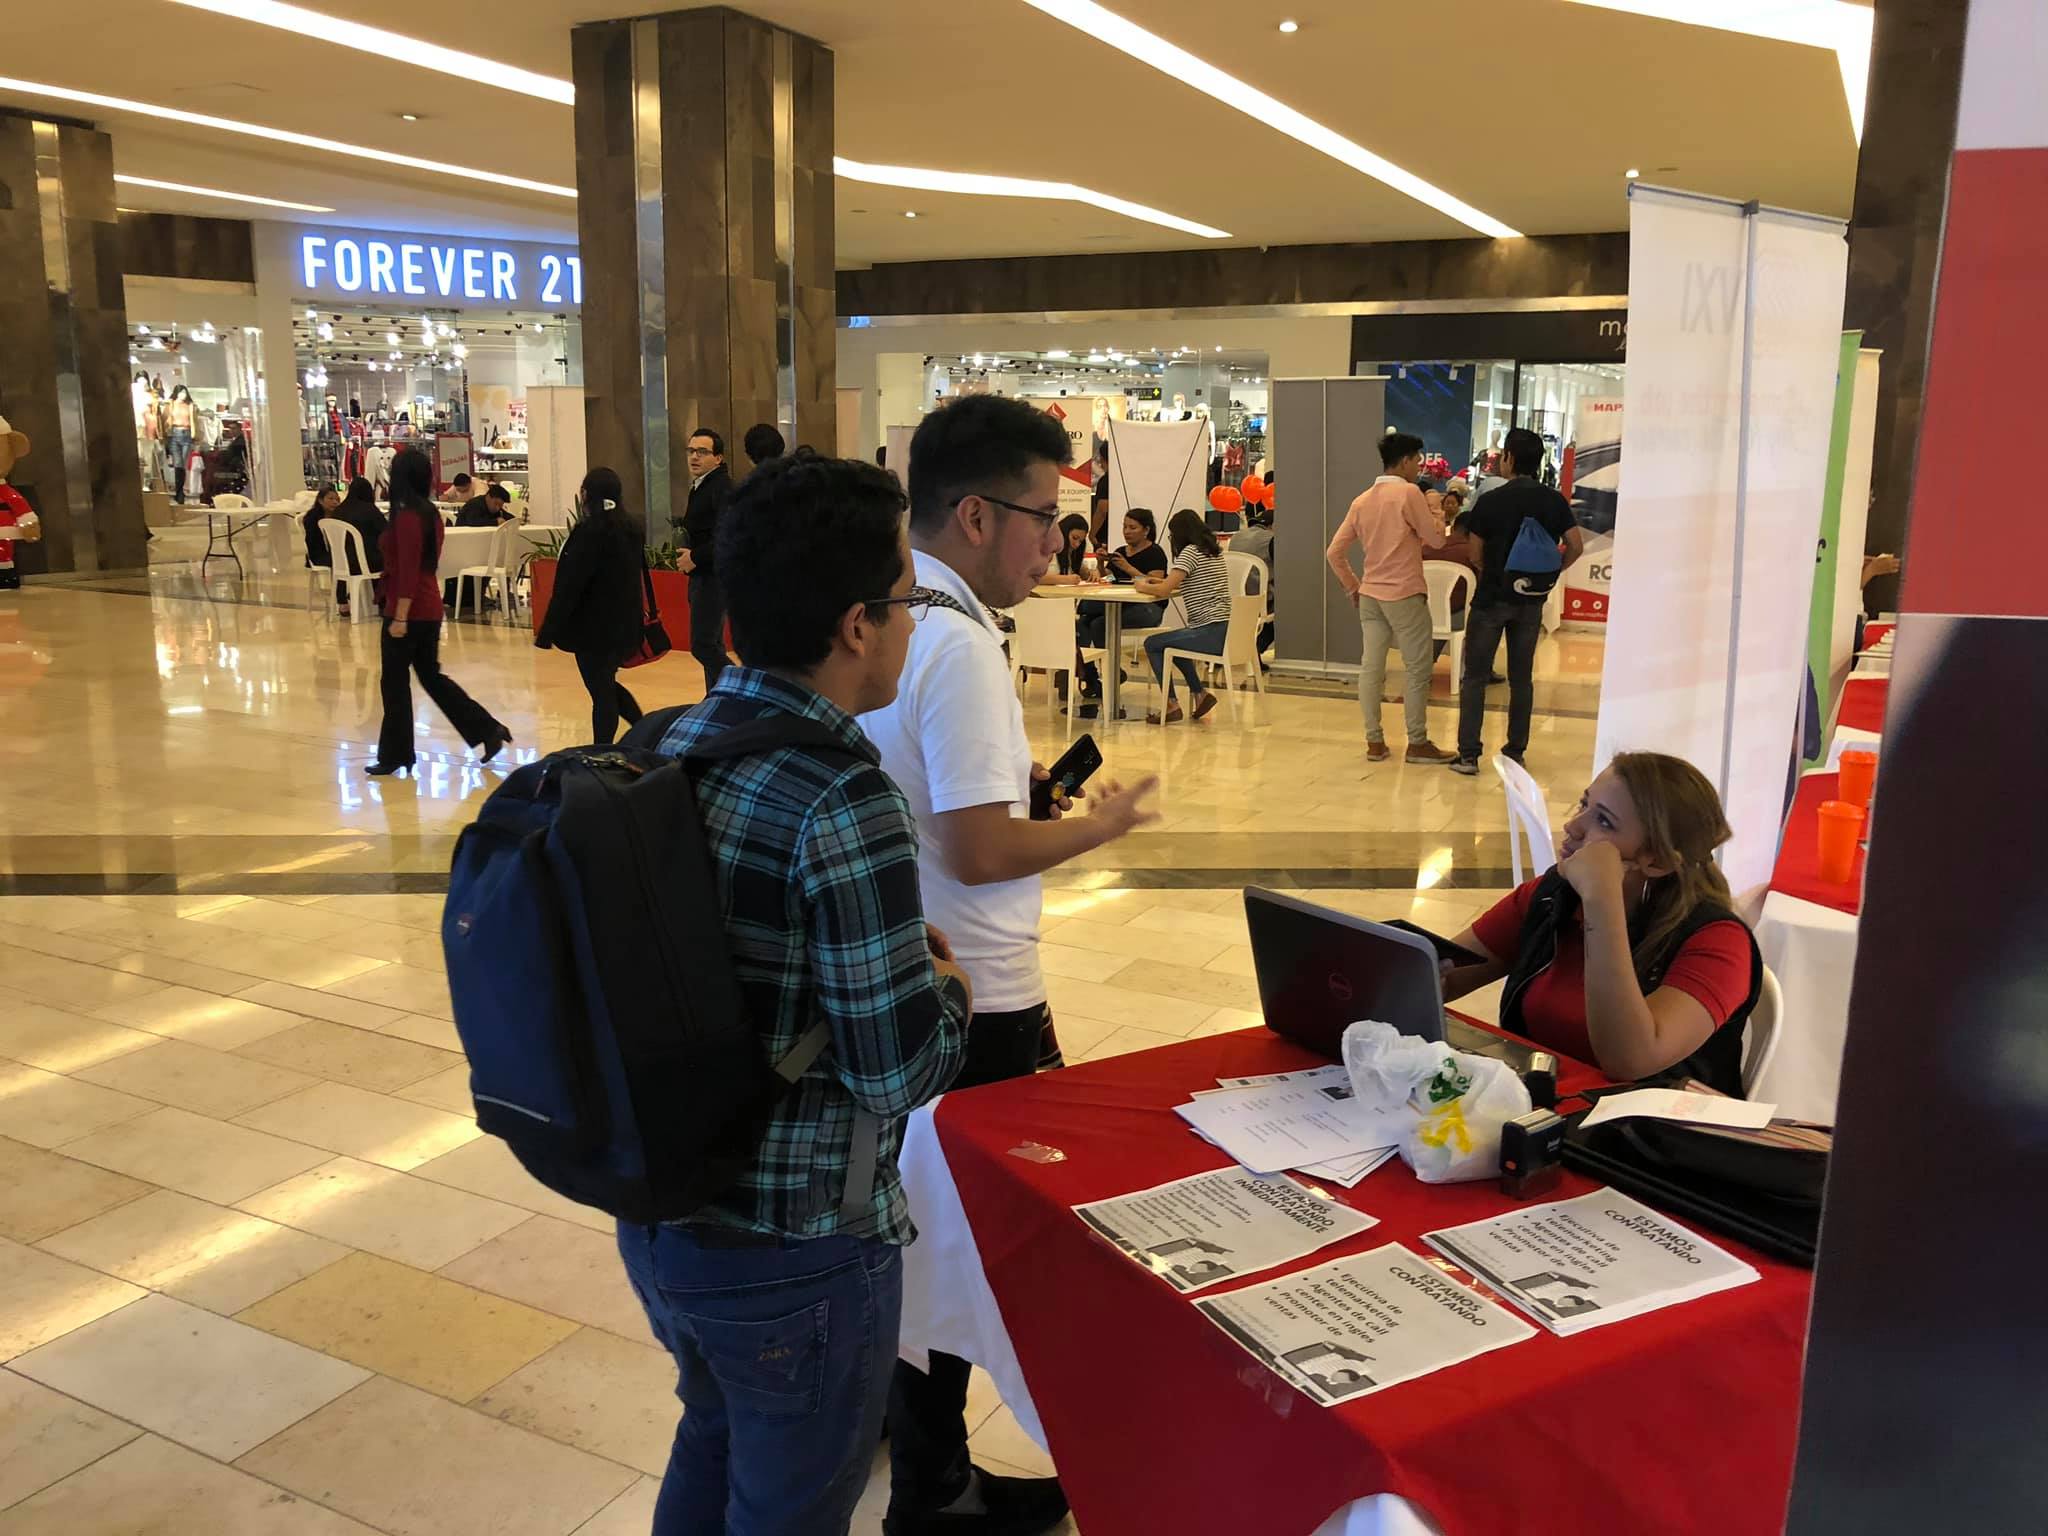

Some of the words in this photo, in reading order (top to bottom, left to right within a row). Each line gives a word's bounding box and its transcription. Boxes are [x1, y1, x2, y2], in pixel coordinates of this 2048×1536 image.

[302, 236, 517, 300] FOREVER
[540, 255, 582, 304] 21
[1594, 403, 1624, 412] MAP
[1234, 1178, 1329, 1235] INMEDIATAMENTE
[1252, 1179, 1335, 1227] CONTRATANDO
[1276, 1184, 1332, 1215] ESTAMOS
[1487, 1231, 1522, 1253] ventas
[1501, 1228, 1550, 1257] Promotor
[1549, 1257, 1565, 1266] de
[1516, 1224, 1549, 1244] center
[1550, 1245, 1562, 1253] en
[1529, 1221, 1572, 1246] Agentes
[1571, 1245, 1586, 1254] de
[1585, 1254, 1608, 1267] call
[1541, 1217, 1619, 1262] telemarketing
[1557, 1214, 1605, 1241] Ejecutiva
[1605, 1241, 1621, 1251] de
[1603, 1209, 1701, 1265] CONTRATANDO
[1633, 1215, 1696, 1251] ESTAMOS
[1264, 1296, 1297, 1320] ventas
[1295, 1287, 1327, 1310] center
[1328, 1310, 1341, 1320] en
[1308, 1283, 1351, 1311] Agentes
[1351, 1310, 1366, 1321] de
[1365, 1320, 1386, 1335] call
[1324, 1278, 1398, 1328] telemarketing
[1339, 1273, 1388, 1305] Ejecutiva
[1387, 1303, 1403, 1314] de
[1388, 1266, 1486, 1327] CONTRATANDO
[1419, 1273, 1481, 1312] ESTAMOS
[1279, 1291, 1326, 1325] Promotor
[1327, 1325, 1342, 1336] de
